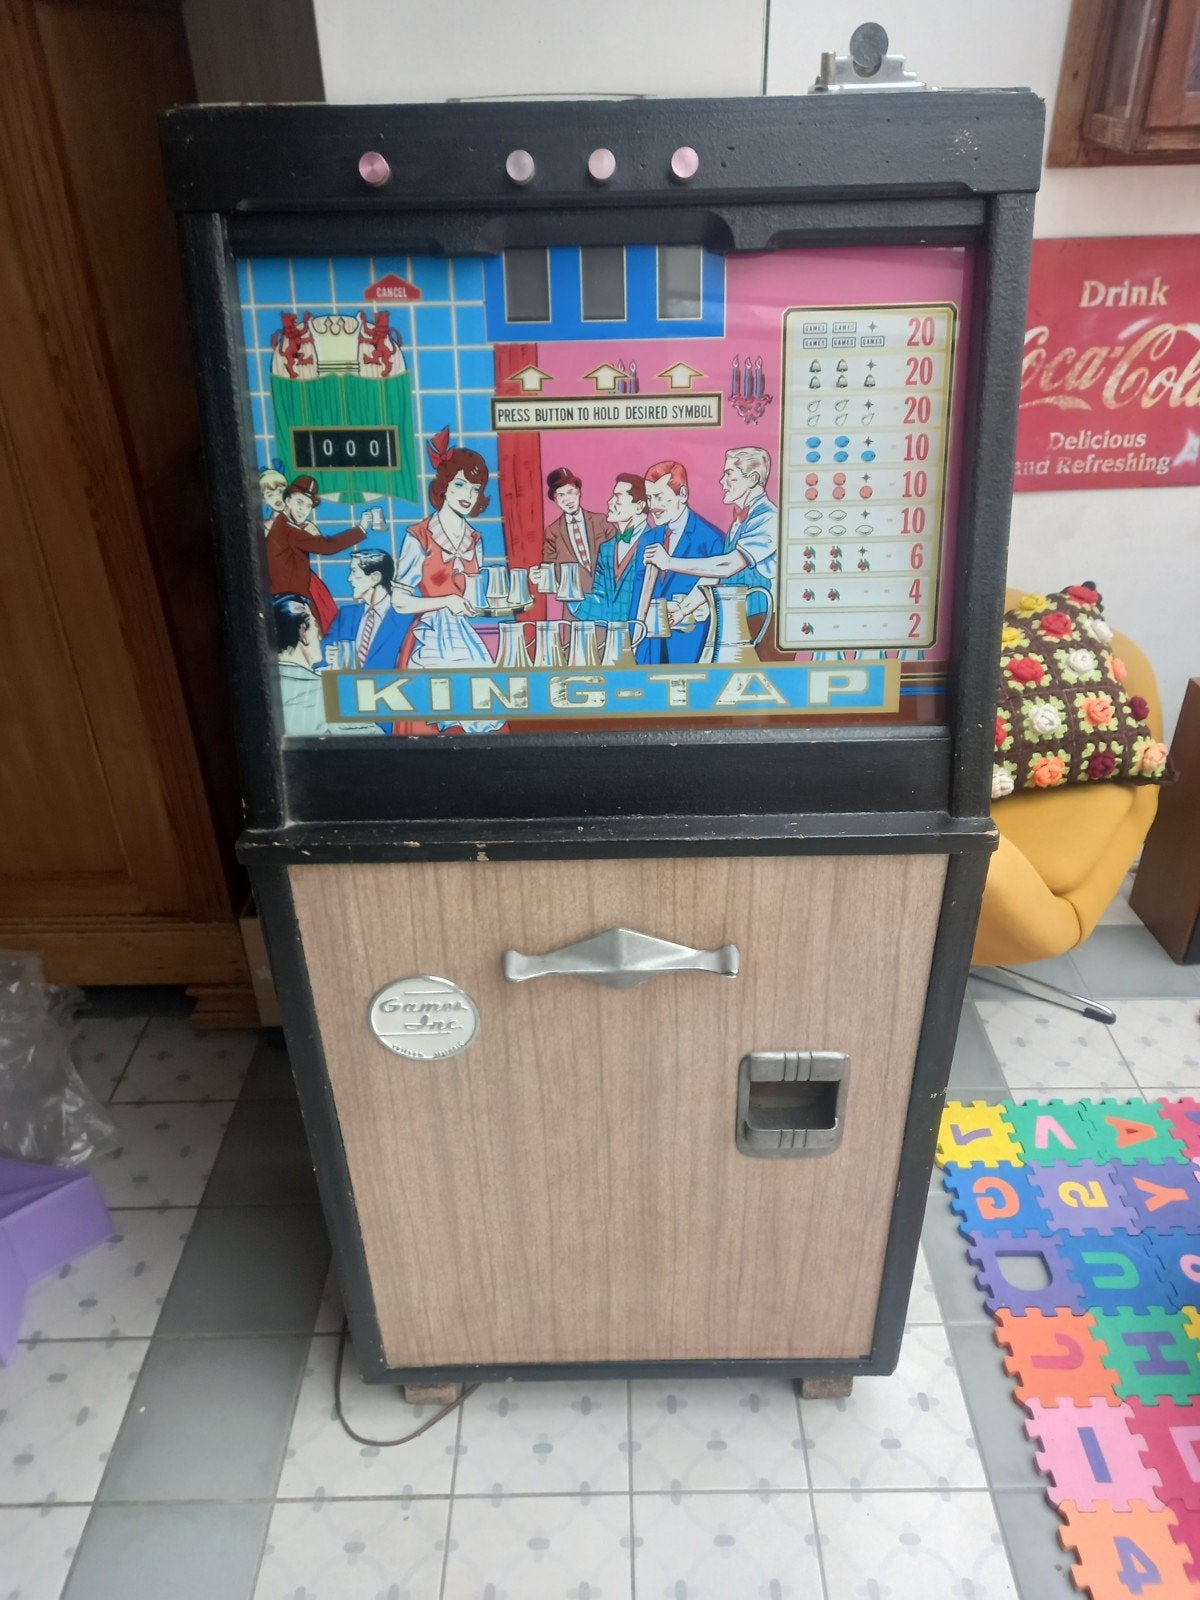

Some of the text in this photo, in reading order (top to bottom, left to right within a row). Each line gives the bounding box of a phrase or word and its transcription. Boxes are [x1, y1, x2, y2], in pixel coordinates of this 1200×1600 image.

[376, 287, 407, 298] CANCEL
[1079, 276, 1170, 308] Drink
[805, 323, 855, 332] GAMES GAMES
[907, 316, 935, 347] 20
[905, 357, 933, 386] 20
[498, 404, 713, 423] PRESS BUTTON TO HOLD DESIRED SYMBOL
[903, 396, 931, 424] 20
[903, 433, 930, 461] 10
[1048, 430, 1147, 451] Delicious
[1055, 453, 1171, 475] Refreshing
[902, 470, 928, 498] 10
[900, 507, 926, 535] 10
[910, 543, 924, 570] 6
[908, 578, 922, 605] 4
[908, 612, 922, 638] 2
[355, 669, 869, 712] KING-TAP
[379, 996, 469, 1013] Games
[1105, 1115, 1157, 1149] A
[1133, 1177, 1189, 1212] Y
[1081, 1251, 1140, 1290] U
[1121, 1331, 1191, 1376] H
